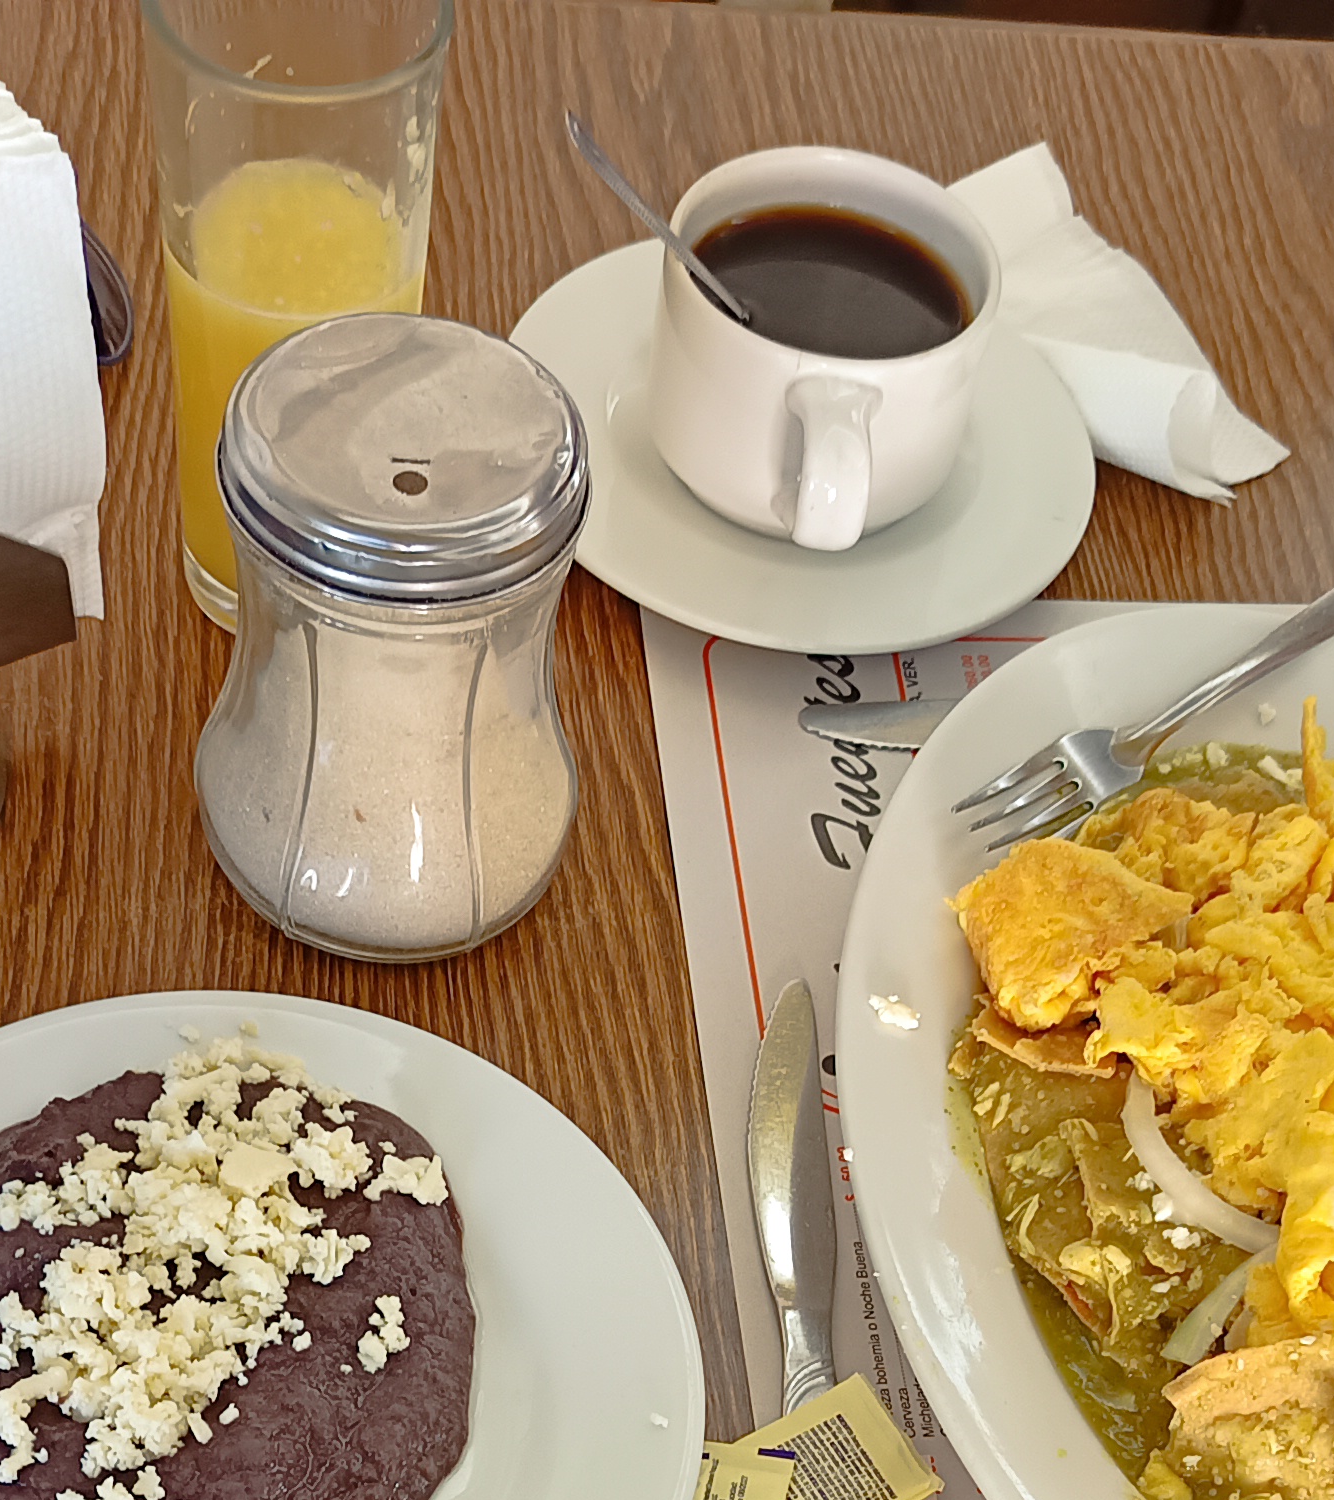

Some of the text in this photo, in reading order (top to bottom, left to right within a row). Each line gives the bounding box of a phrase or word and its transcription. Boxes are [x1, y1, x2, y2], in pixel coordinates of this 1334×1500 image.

[854, 1241, 868, 1278] Buena
[860, 1282, 875, 1319] Noche
[870, 1334, 887, 1384] bohemia
[899, 1388, 916, 1441] Cerveza
